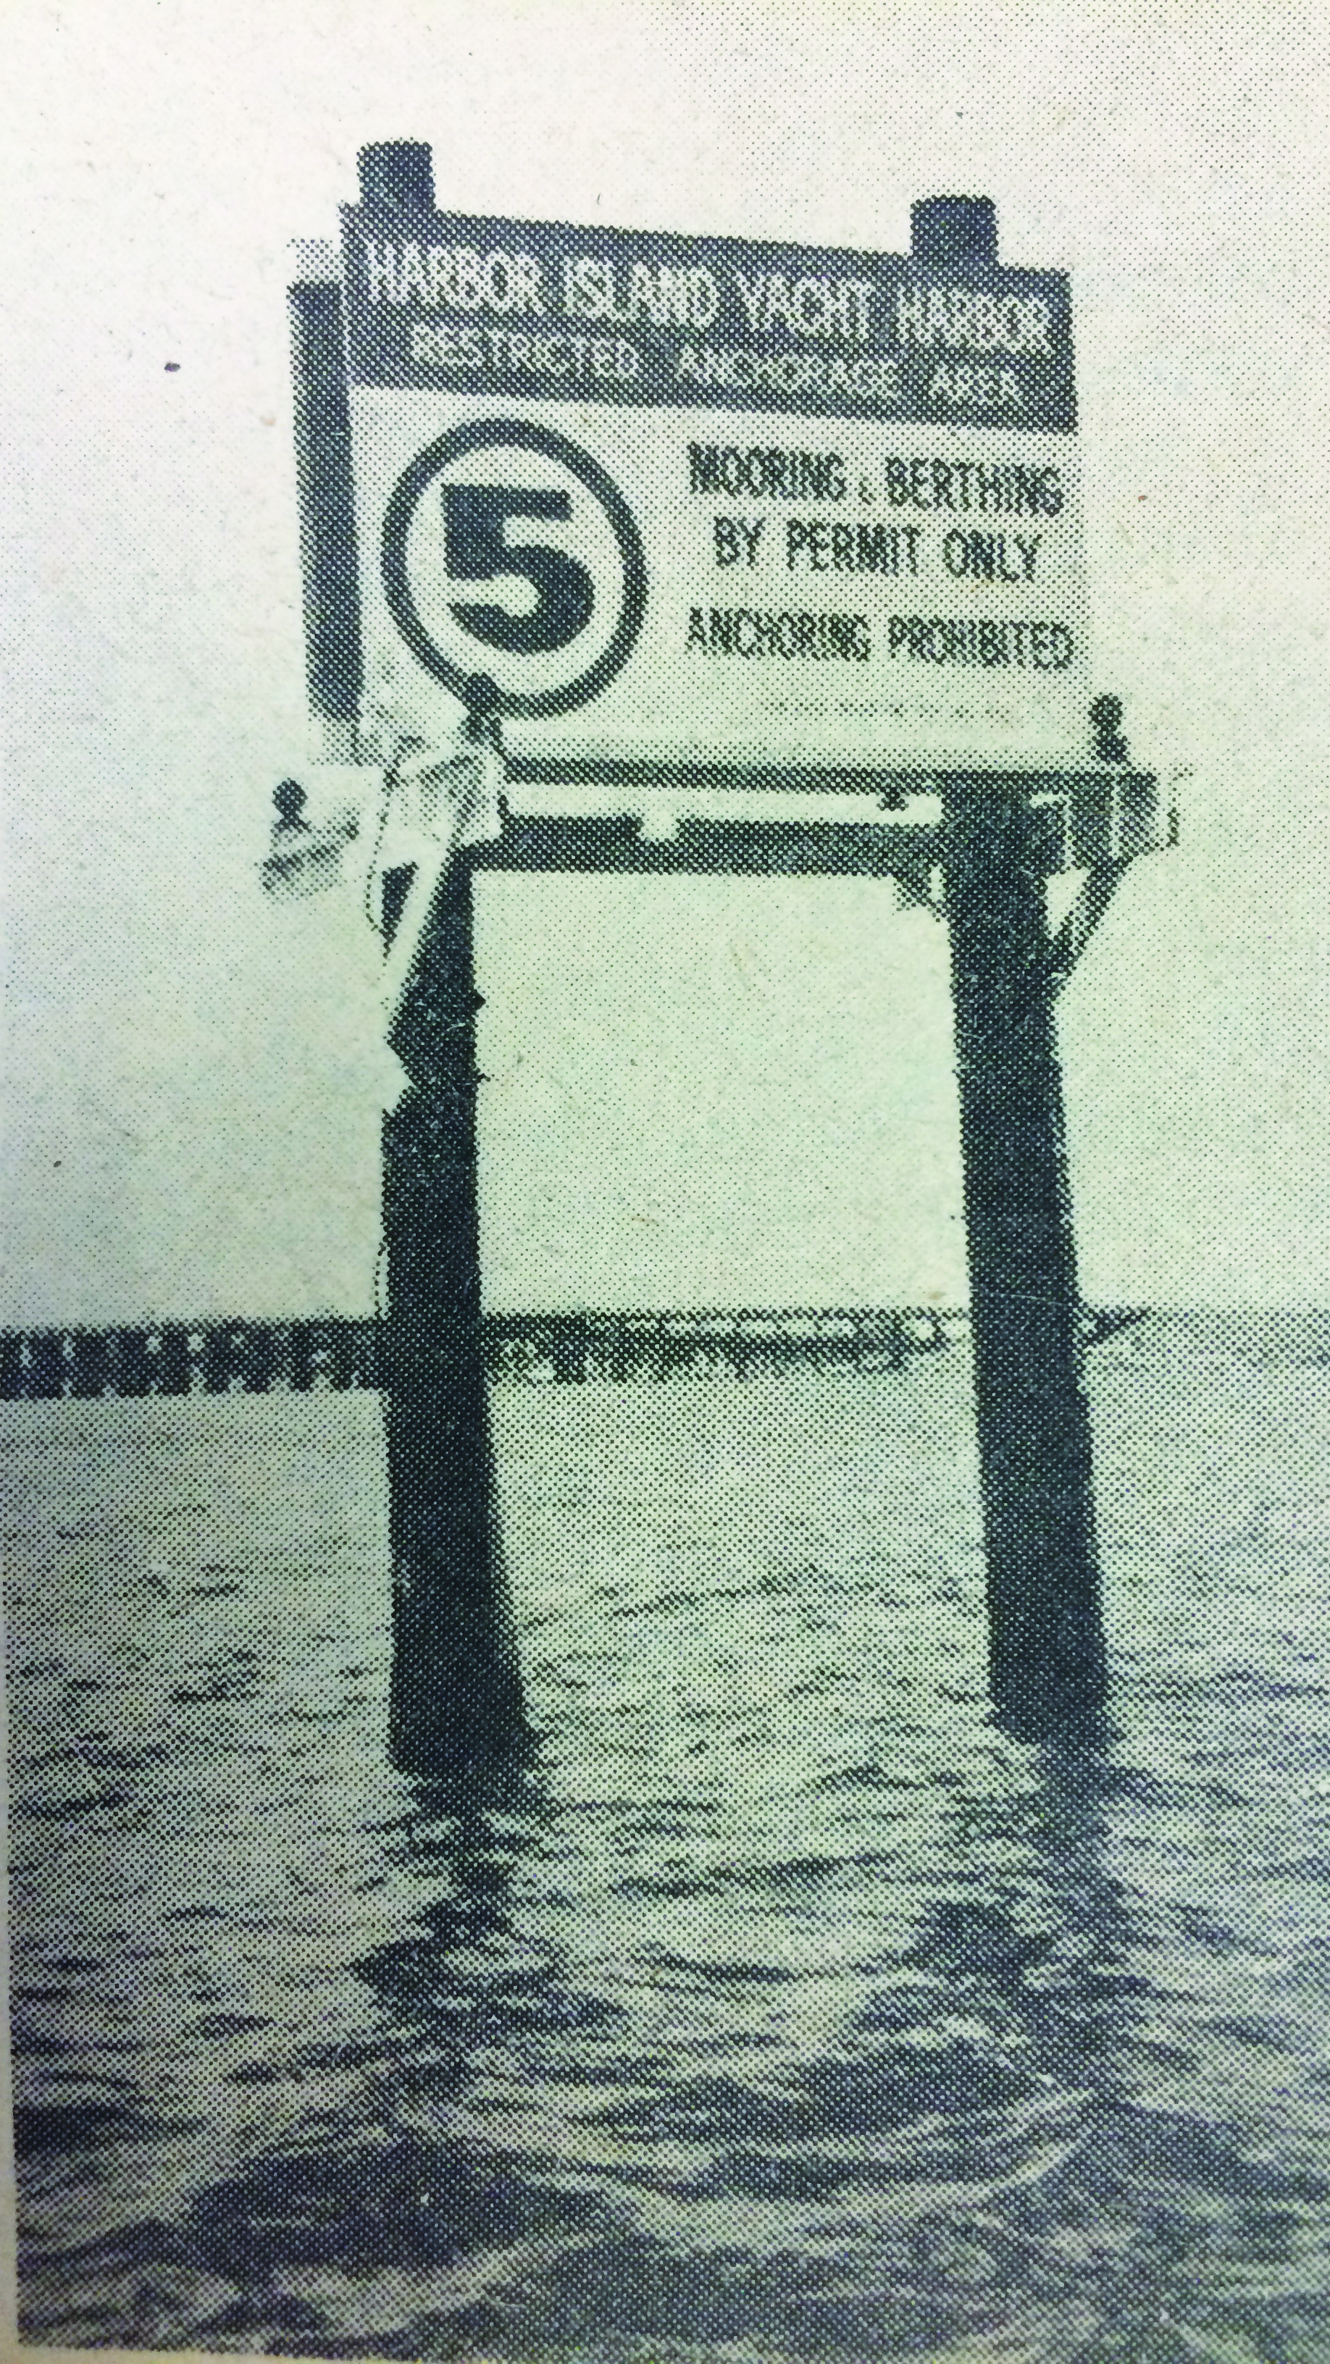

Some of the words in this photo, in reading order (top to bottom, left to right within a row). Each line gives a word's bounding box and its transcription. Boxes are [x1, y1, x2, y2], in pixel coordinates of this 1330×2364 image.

[366, 241, 547, 316] HARBOR
[563, 256, 719, 329] ISLAND
[735, 270, 876, 340] YACHT
[896, 285, 1053, 355] HARBOR
[411, 323, 642, 381] RESTRICTED
[675, 347, 902, 399] ANCHORAGE
[928, 365, 1024, 406] AREA
[687, 441, 848, 501] MOORING
[885, 457, 1065, 518] BERTHING
[441, 483, 595, 656] 5
[714, 516, 766, 571] BY
[786, 518, 921, 577] PERMIT
[943, 528, 1043, 583] ONLY
[685, 607, 872, 662] ANCHORING
[888, 614, 1074, 670] PROHIBITED
